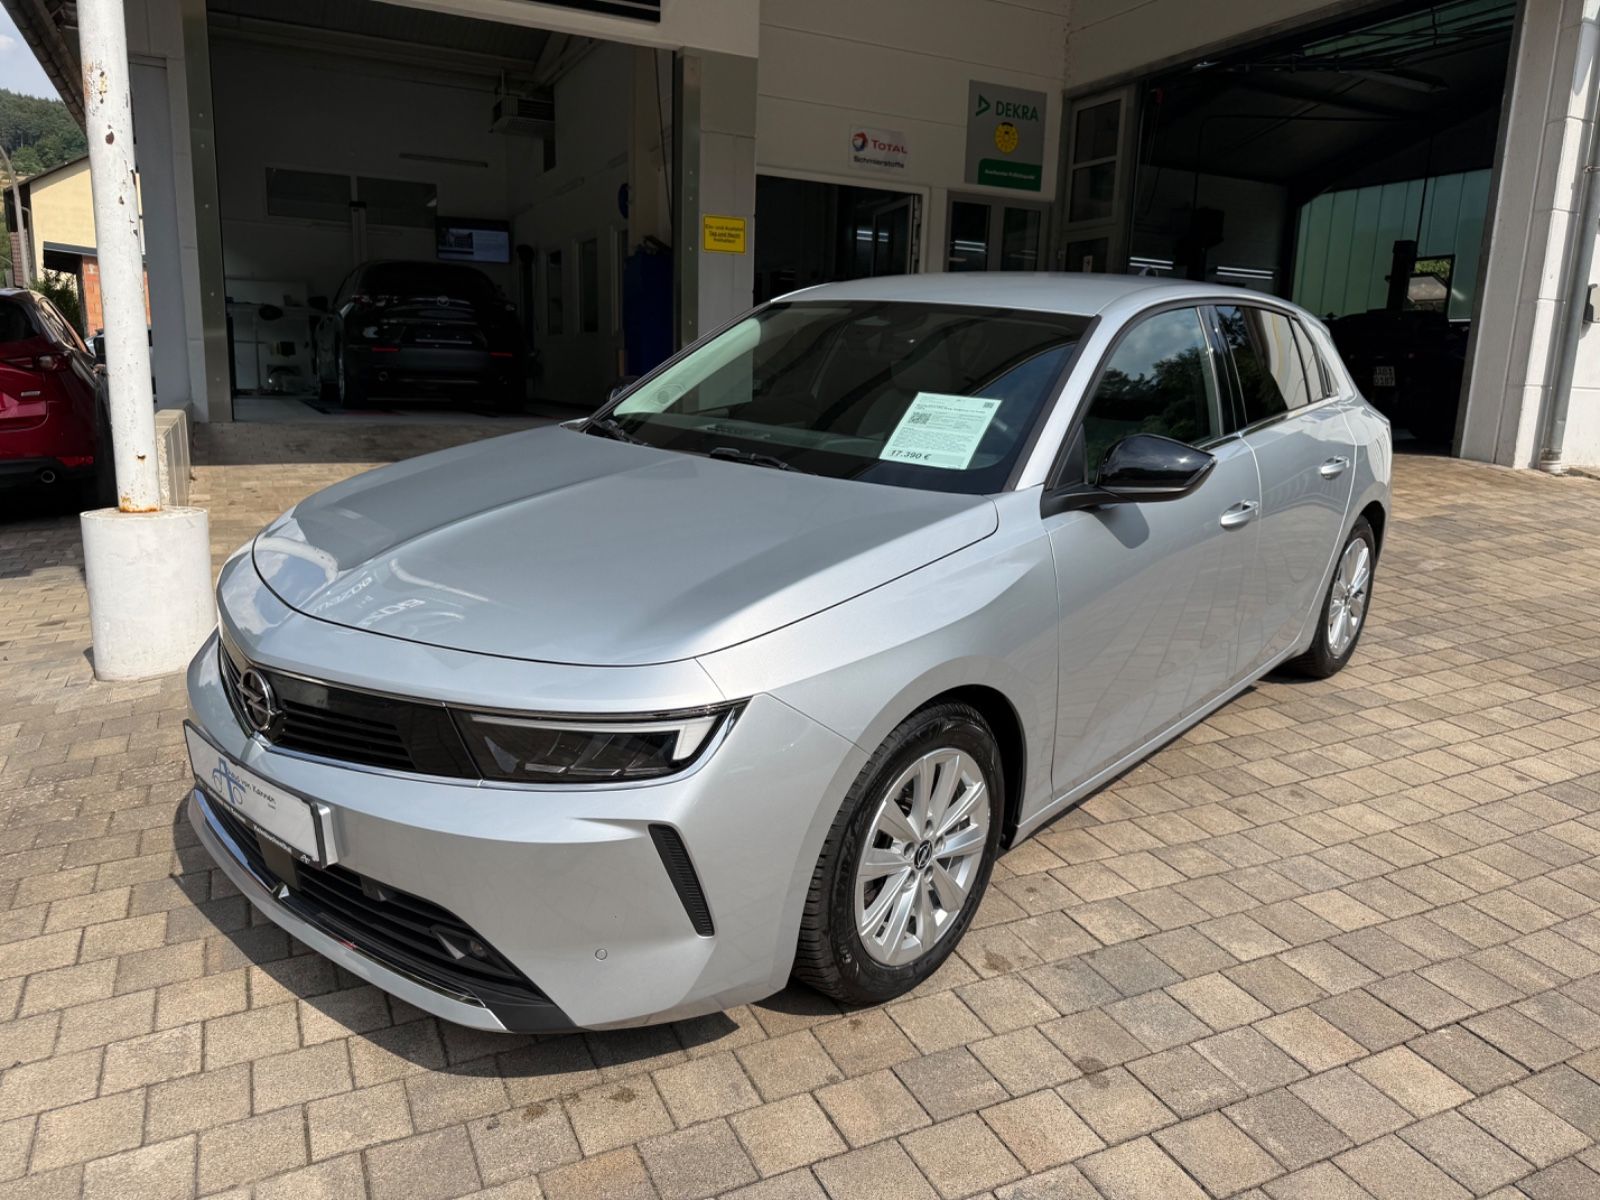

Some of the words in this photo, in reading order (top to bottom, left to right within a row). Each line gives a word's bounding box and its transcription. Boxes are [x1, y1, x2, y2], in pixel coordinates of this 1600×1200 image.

[995, 100, 1039, 122] DEKRA
[891, 449, 922, 460] 17.390
[923, 453, 932, 461] €
